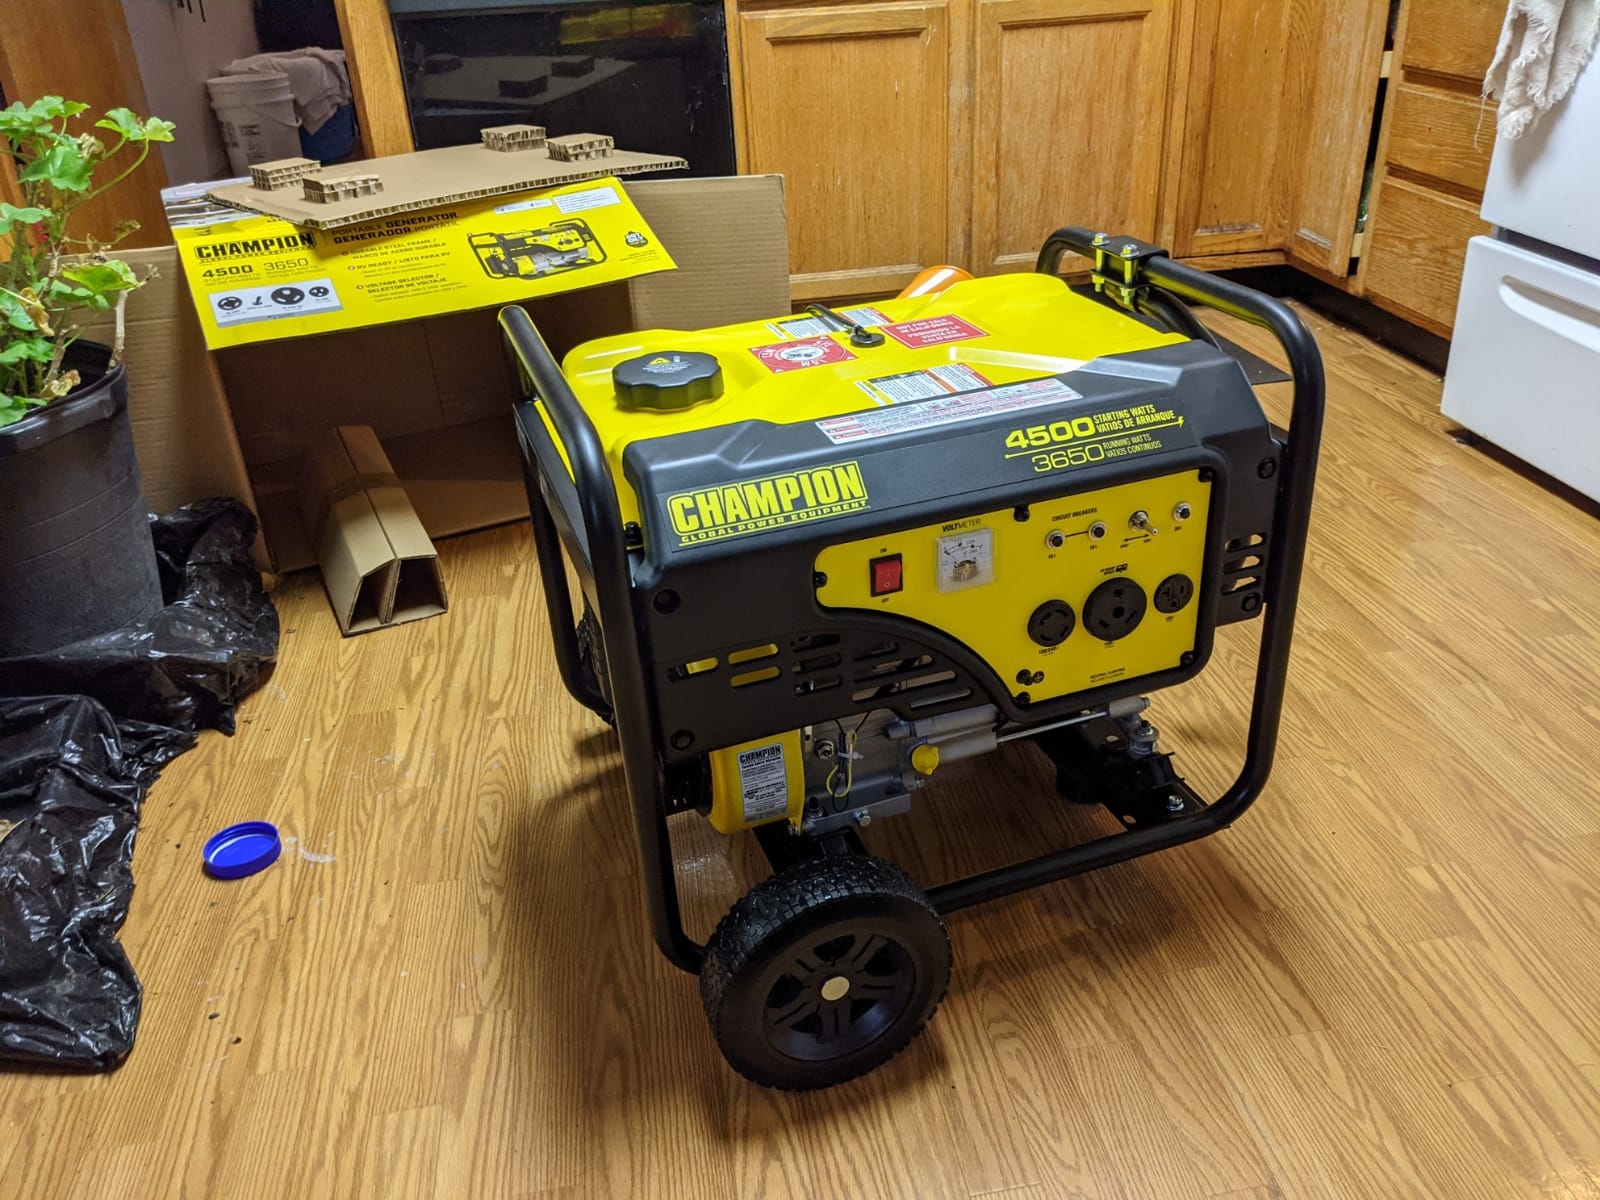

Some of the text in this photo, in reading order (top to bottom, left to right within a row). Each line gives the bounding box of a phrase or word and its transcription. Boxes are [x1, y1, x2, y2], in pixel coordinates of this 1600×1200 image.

[332, 211, 458, 235] PORTABLE GENERATOR
[333, 227, 411, 244] GENERADOR
[196, 232, 315, 260] CHAMPION
[202, 264, 253, 278] 4500
[263, 258, 309, 272] 3650
[367, 284, 404, 294] SELECTOR
[1093, 404, 1156, 424] STARTING WATTS
[1096, 410, 1176, 433] VATIOS DE ARRANQUE
[1005, 417, 1096, 449] 4500
[1103, 434, 1152, 450] RUNNING WATTS
[1031, 444, 1105, 472] 3650
[1105, 440, 1162, 459] VATIOS CONTINUOS
[669, 463, 866, 534] CHAMPION
[681, 500, 867, 543] GLOBAL POWER EQUIPMENT
[1052, 507, 1098, 522] CIRCUIT BREAKERS
[942, 519, 981, 532] VOLTMETER
[740, 744, 781, 763] CHAMPION
